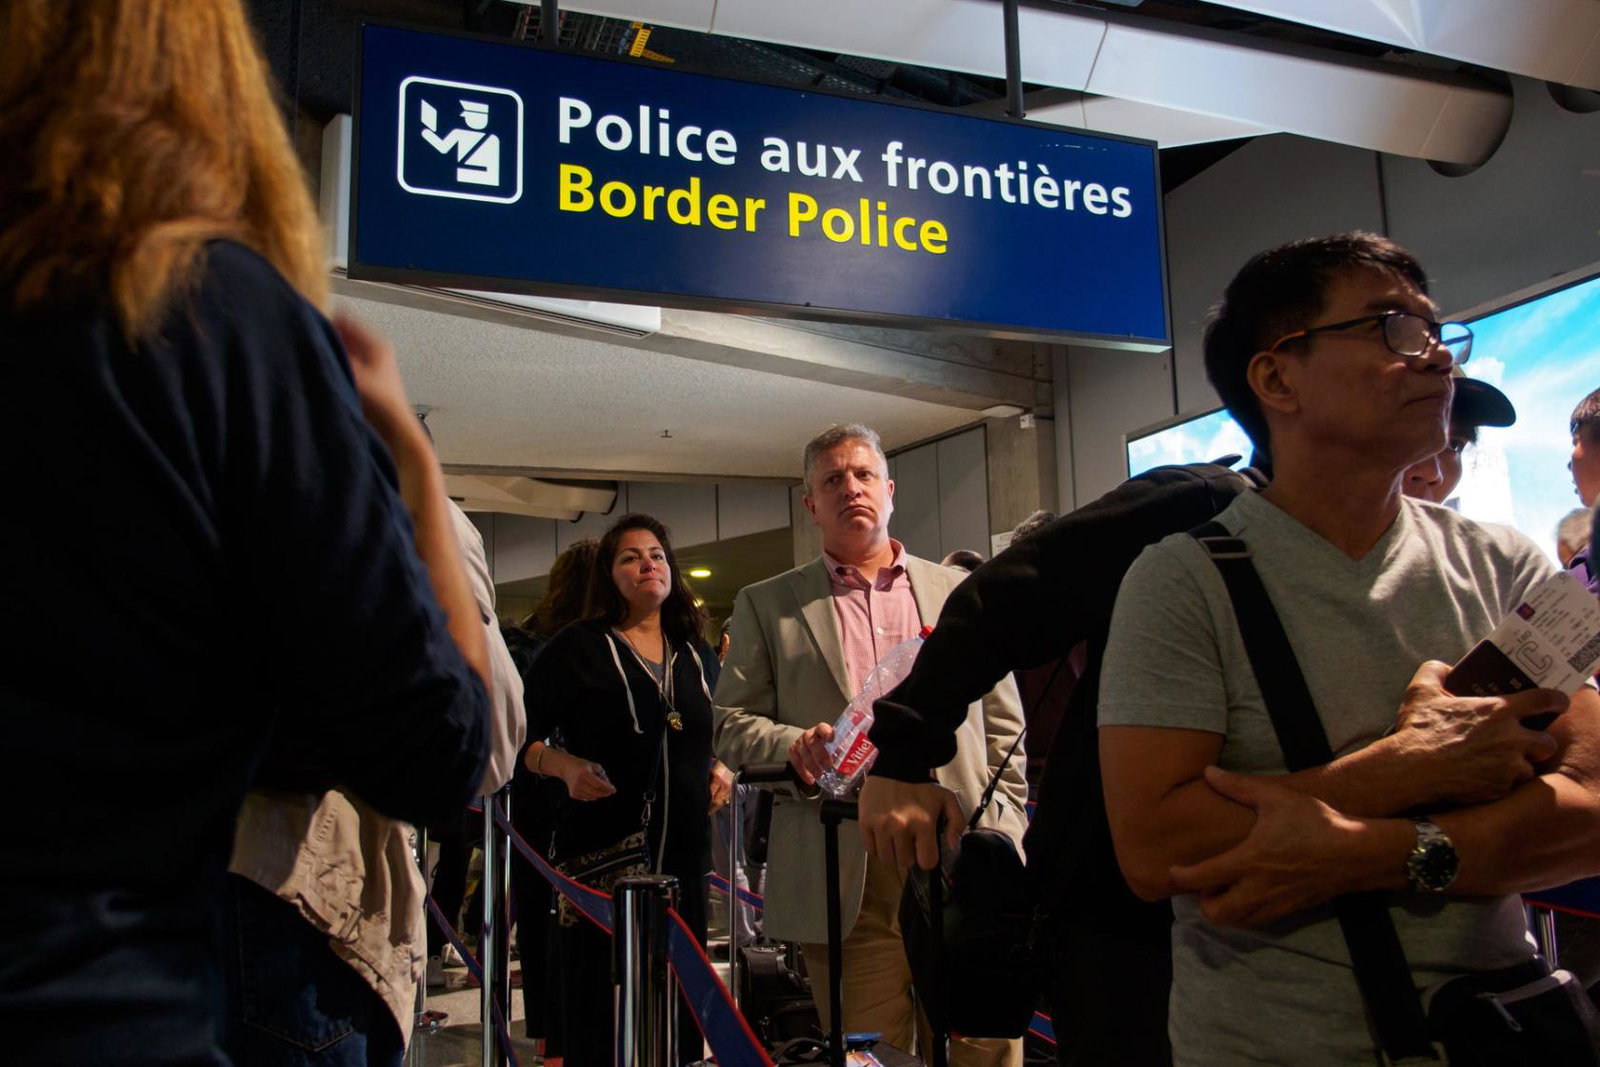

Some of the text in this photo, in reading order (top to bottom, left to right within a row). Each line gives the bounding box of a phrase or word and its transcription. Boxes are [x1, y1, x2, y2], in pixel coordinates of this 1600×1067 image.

[559, 96, 1133, 219] Police aux frontières
[559, 163, 949, 255] Border Police
[846, 738, 872, 764] Vittel
